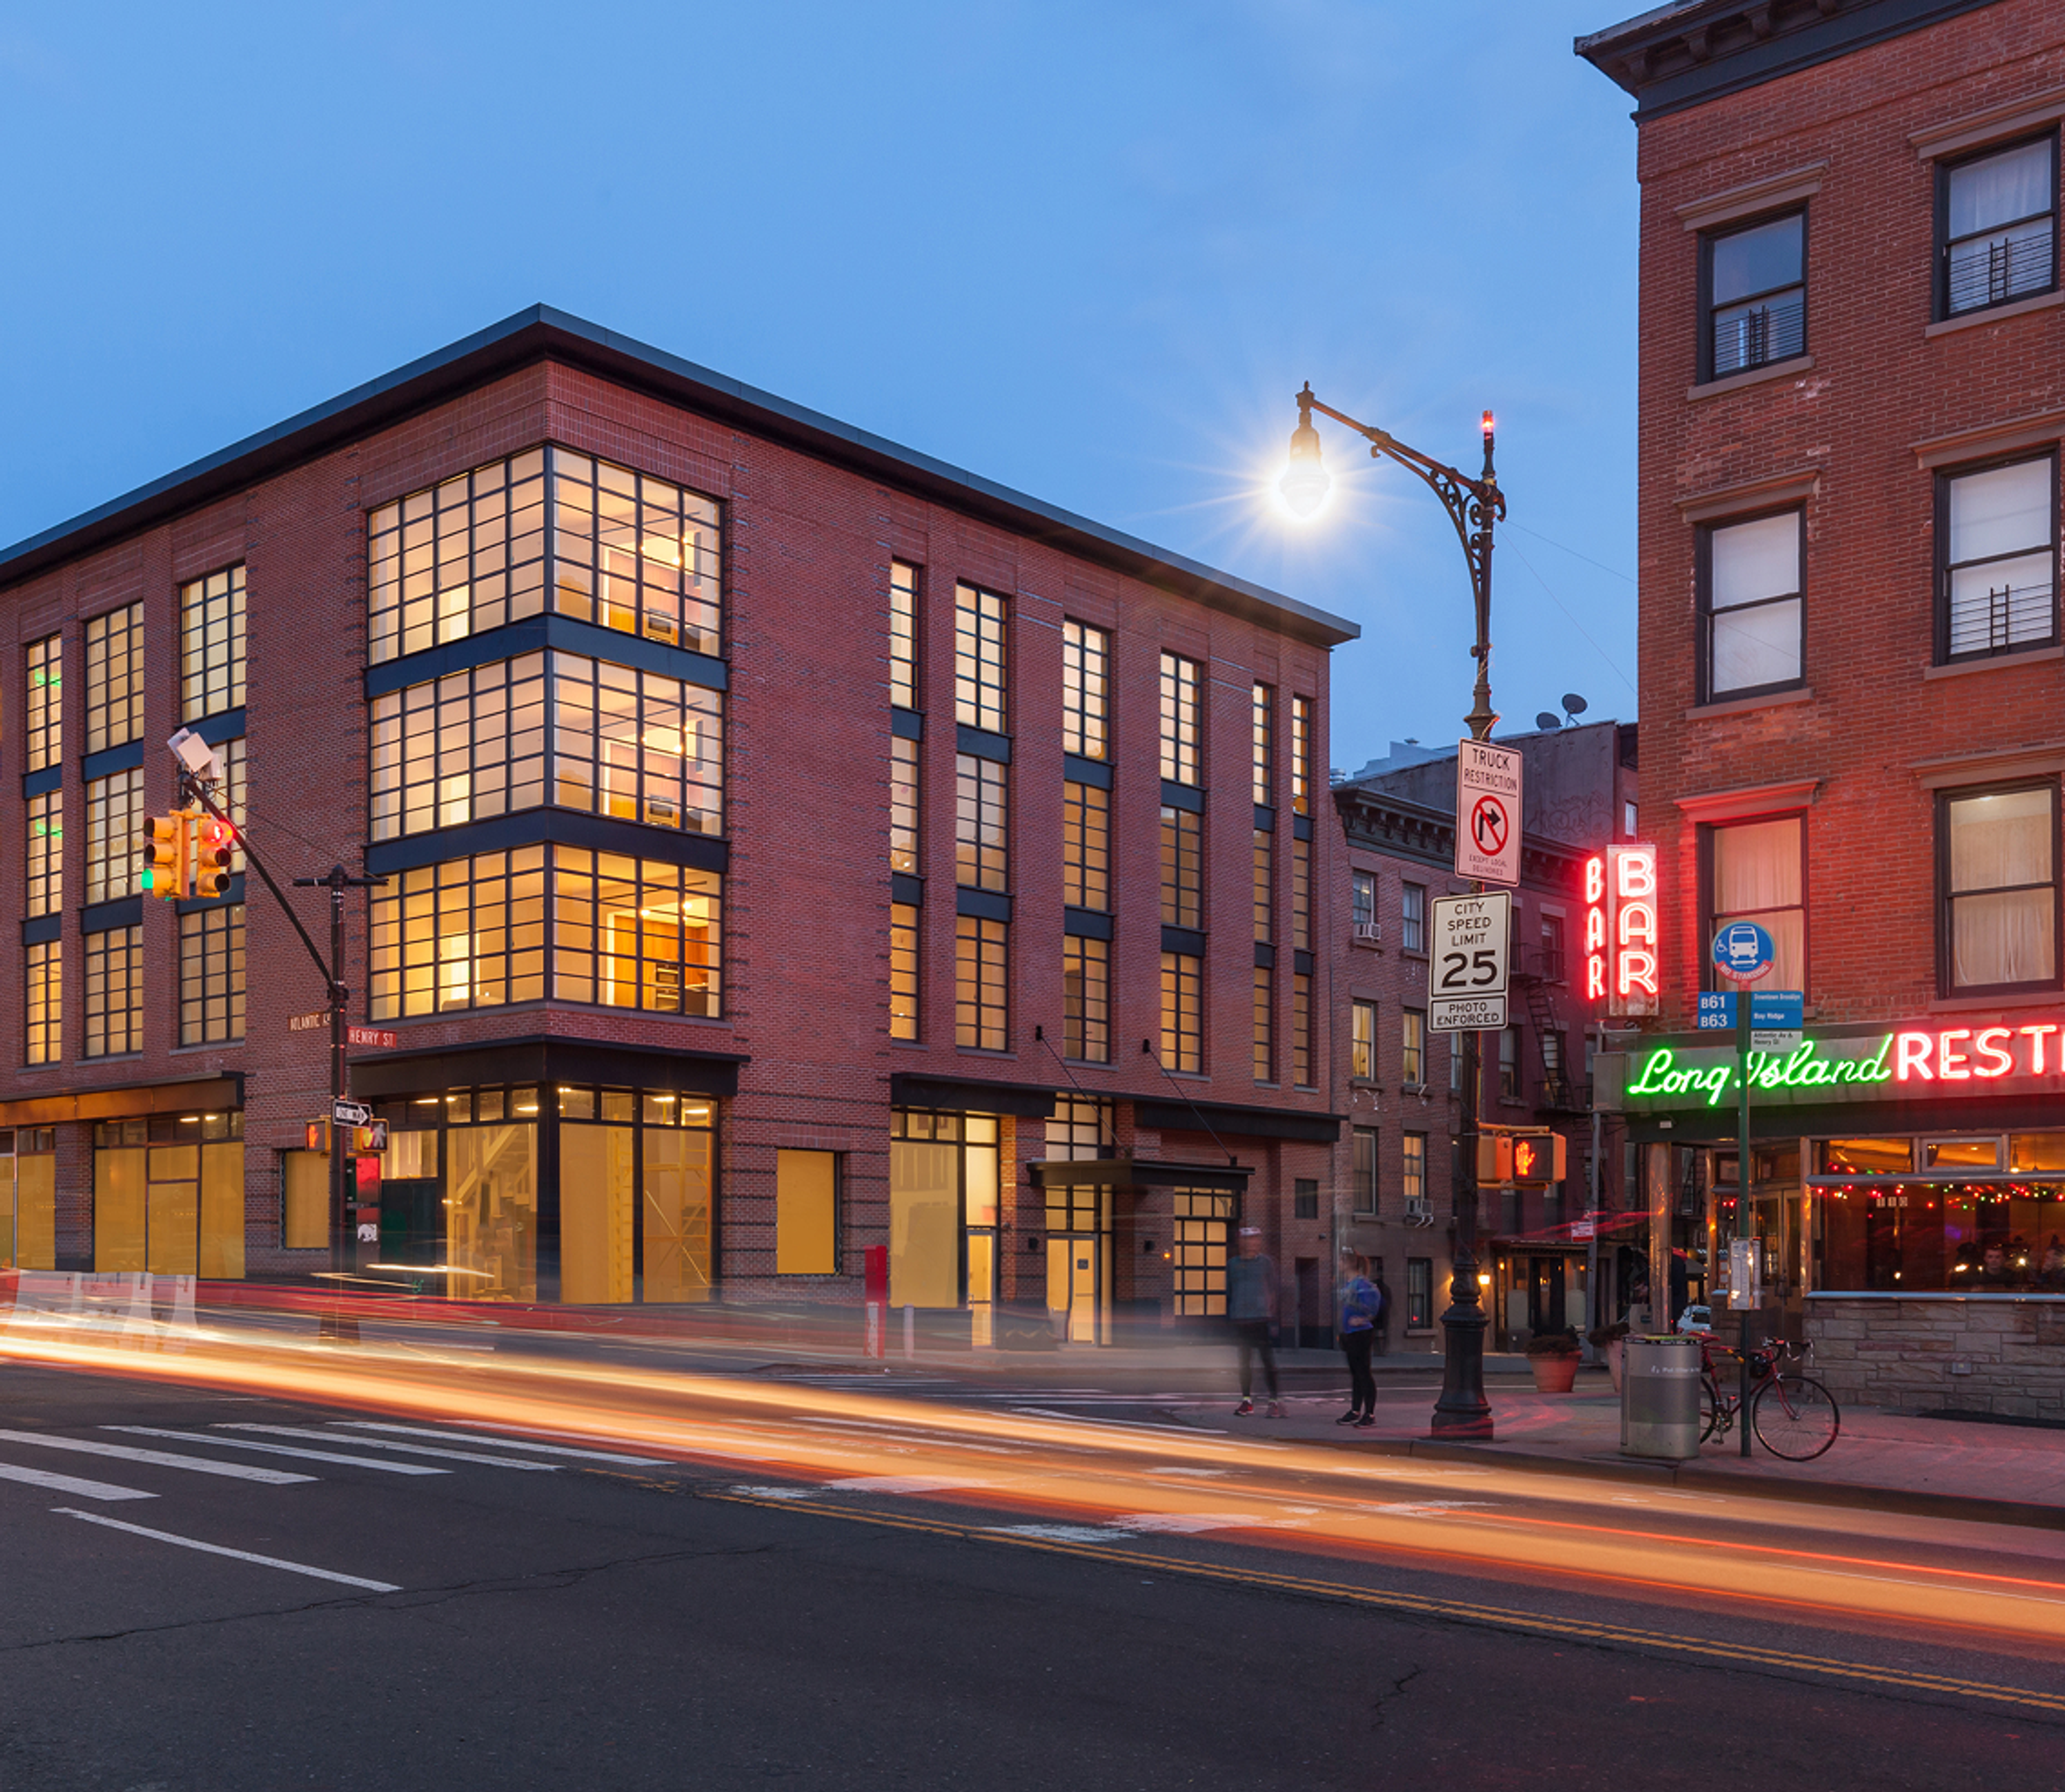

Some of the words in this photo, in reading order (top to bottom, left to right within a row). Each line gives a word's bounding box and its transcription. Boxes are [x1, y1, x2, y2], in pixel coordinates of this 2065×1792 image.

[1473, 748, 1510, 771] TRUCK
[1464, 768, 1518, 791] RESTRICTION
[1454, 902, 1485, 915] CITY
[1447, 917, 1492, 931] SPEED
[1586, 856, 1605, 1000] BAR
[1618, 852, 1658, 995] BAR
[1451, 932, 1486, 947] LIMIT
[1441, 949, 1498, 988] 25
[1719, 964, 1732, 976] NO
[1449, 1002, 1487, 1014] PHOTO
[1701, 995, 1726, 1009] B61
[290, 1013, 321, 1031] ATLANTIC
[1436, 1012, 1499, 1025] ENFORCED
[1700, 1013, 1728, 1027] B63
[1754, 1012, 1766, 1021] Bay
[1767, 1012, 1785, 1021] Ridge
[348, 1029, 379, 1045] HENRY
[383, 1032, 393, 1047] ST
[1628, 1048, 1732, 1106] Long
[1734, 1032, 1895, 1088] Island
[1897, 1024, 2065, 1082] REST
